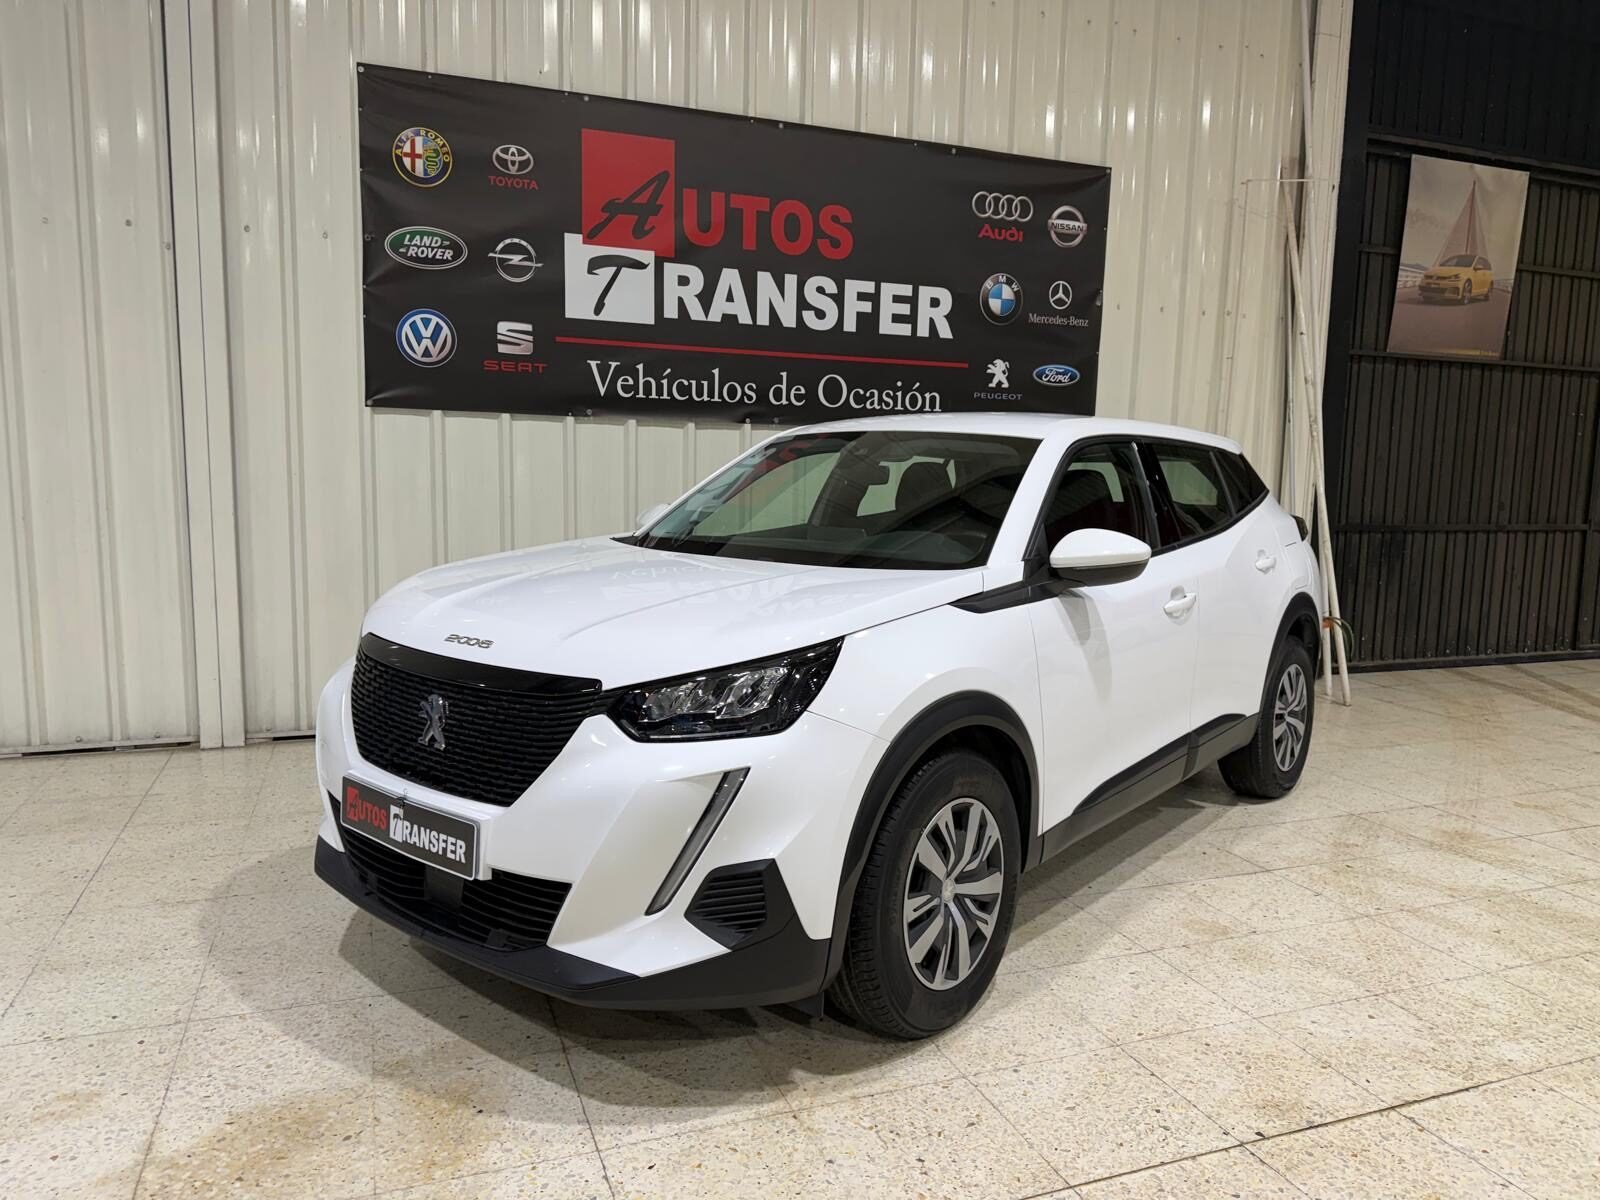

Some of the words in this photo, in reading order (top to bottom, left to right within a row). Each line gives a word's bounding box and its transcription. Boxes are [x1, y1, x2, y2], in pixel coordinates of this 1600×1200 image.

[488, 175, 539, 191] TOYOTA
[587, 170, 855, 261] AUTOS
[1052, 222, 1084, 233] NISSAN
[984, 275, 1021, 292] BMW
[587, 254, 954, 340] TRANSFER
[1028, 312, 1089, 328] Mercedes-Benz
[483, 360, 547, 374] SEAT
[1041, 367, 1072, 383] Ford
[586, 359, 757, 404] Vehículos
[768, 371, 806, 407] de
[817, 373, 942, 413] Ocasión
[973, 391, 1023, 401] PEUGEOT
[444, 633, 495, 649] 2008
[348, 789, 388, 831] AUTOS
[392, 810, 466, 864] TRANSFER
